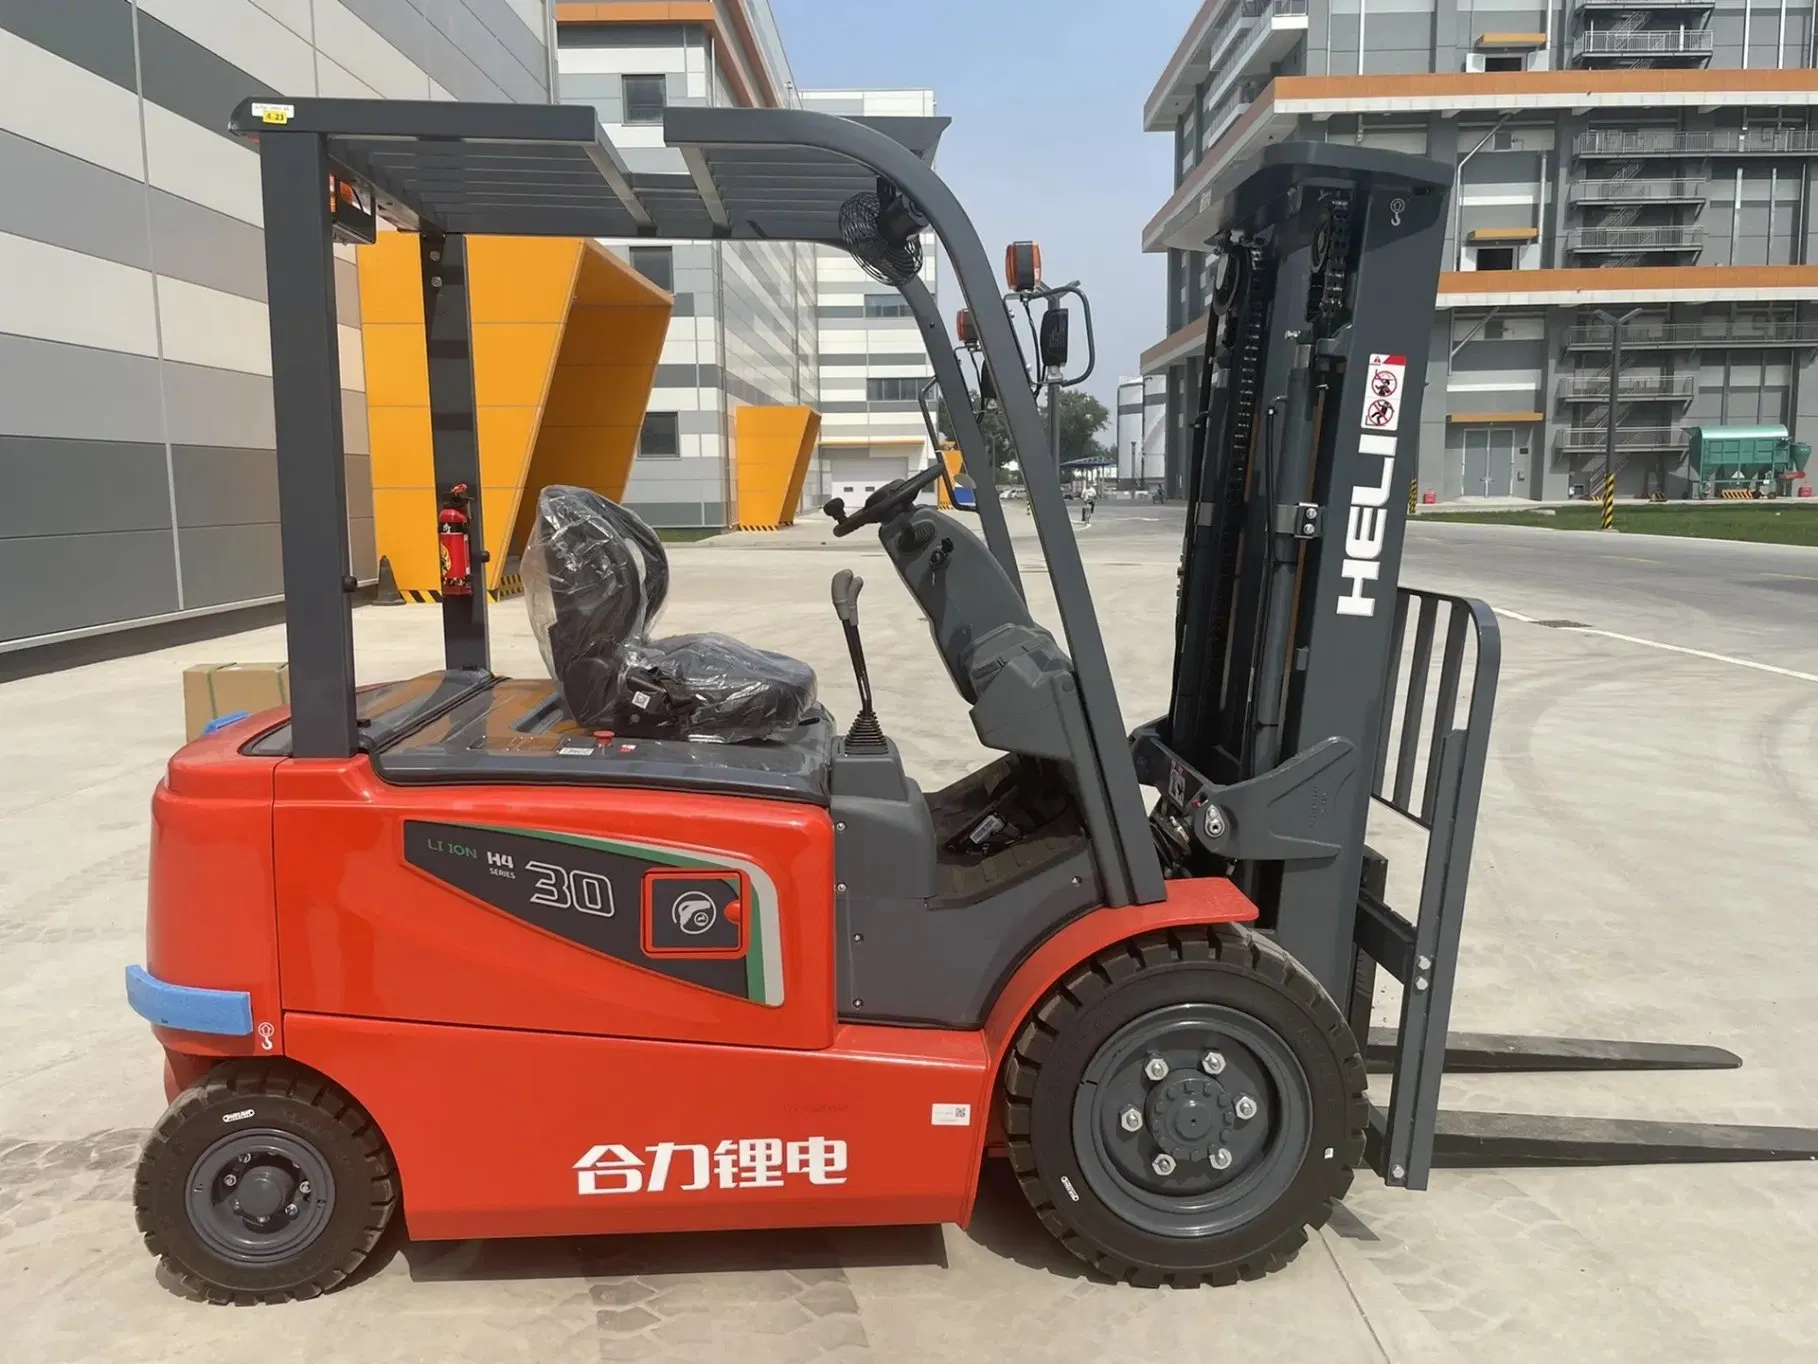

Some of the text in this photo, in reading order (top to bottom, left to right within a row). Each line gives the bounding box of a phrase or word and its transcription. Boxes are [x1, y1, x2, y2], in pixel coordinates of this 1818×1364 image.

[1336, 434, 1398, 617] HELI
[427, 838, 477, 859] LI ION
[486, 851, 514, 868] H4
[489, 867, 516, 880] SERIES
[525, 860, 615, 918] 30
[571, 1136, 848, 1196] 合力锂电
